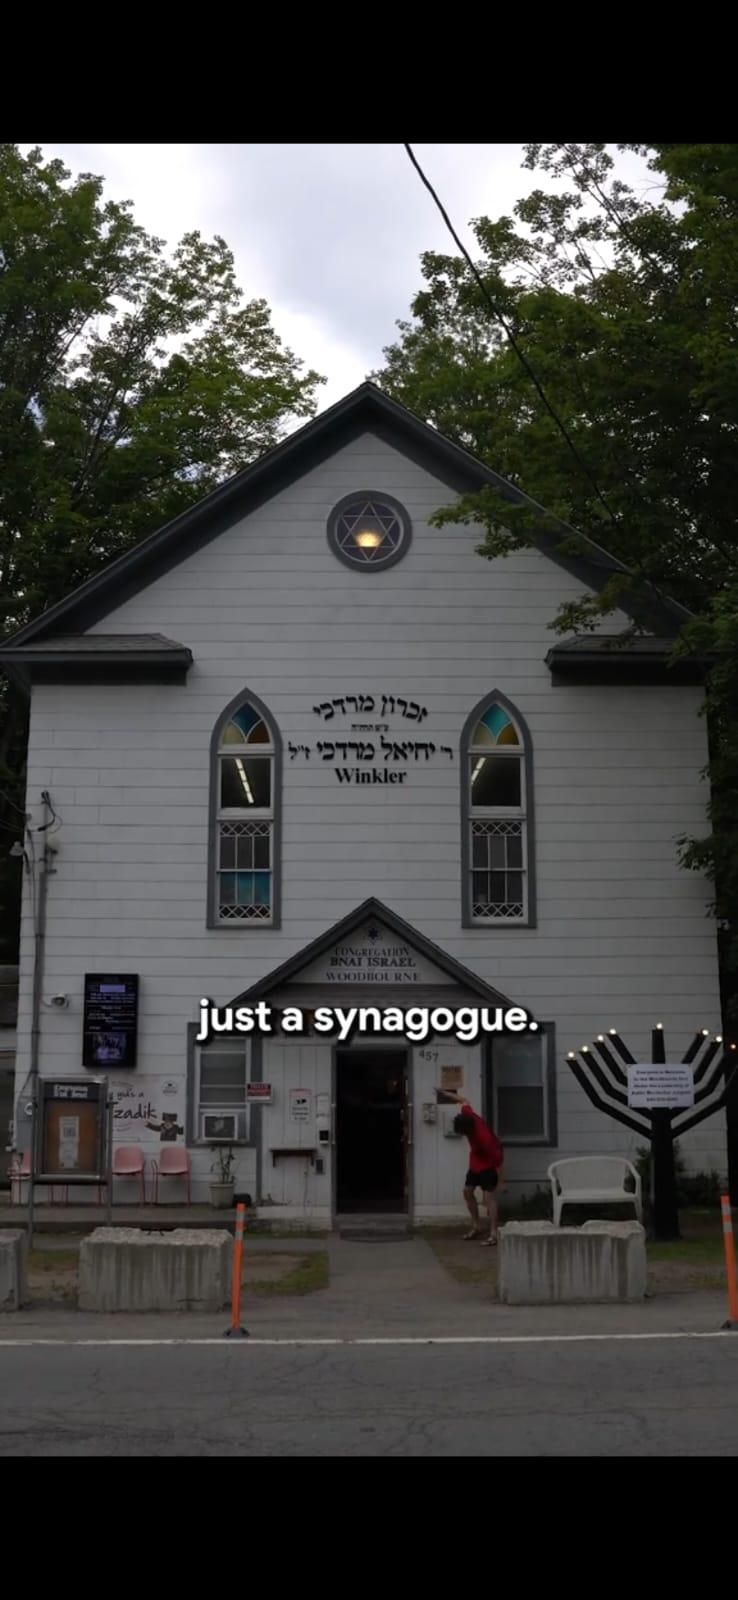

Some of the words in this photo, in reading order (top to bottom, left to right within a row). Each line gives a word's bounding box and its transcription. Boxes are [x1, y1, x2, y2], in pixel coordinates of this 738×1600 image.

[312, 694, 375, 720] מרדכי
[380, 695, 428, 723] זכרון
[316, 741, 375, 760] מרדכי
[380, 736, 436, 760] יחיאל
[335, 768, 407, 784] Winkler
[335, 947, 410, 958] CONGREGATION
[330, 957, 362, 967] BNAI
[367, 957, 416, 967] ISRAEL
[326, 971, 420, 982] WOODBOURNE
[418, 1050, 439, 1063] 457
